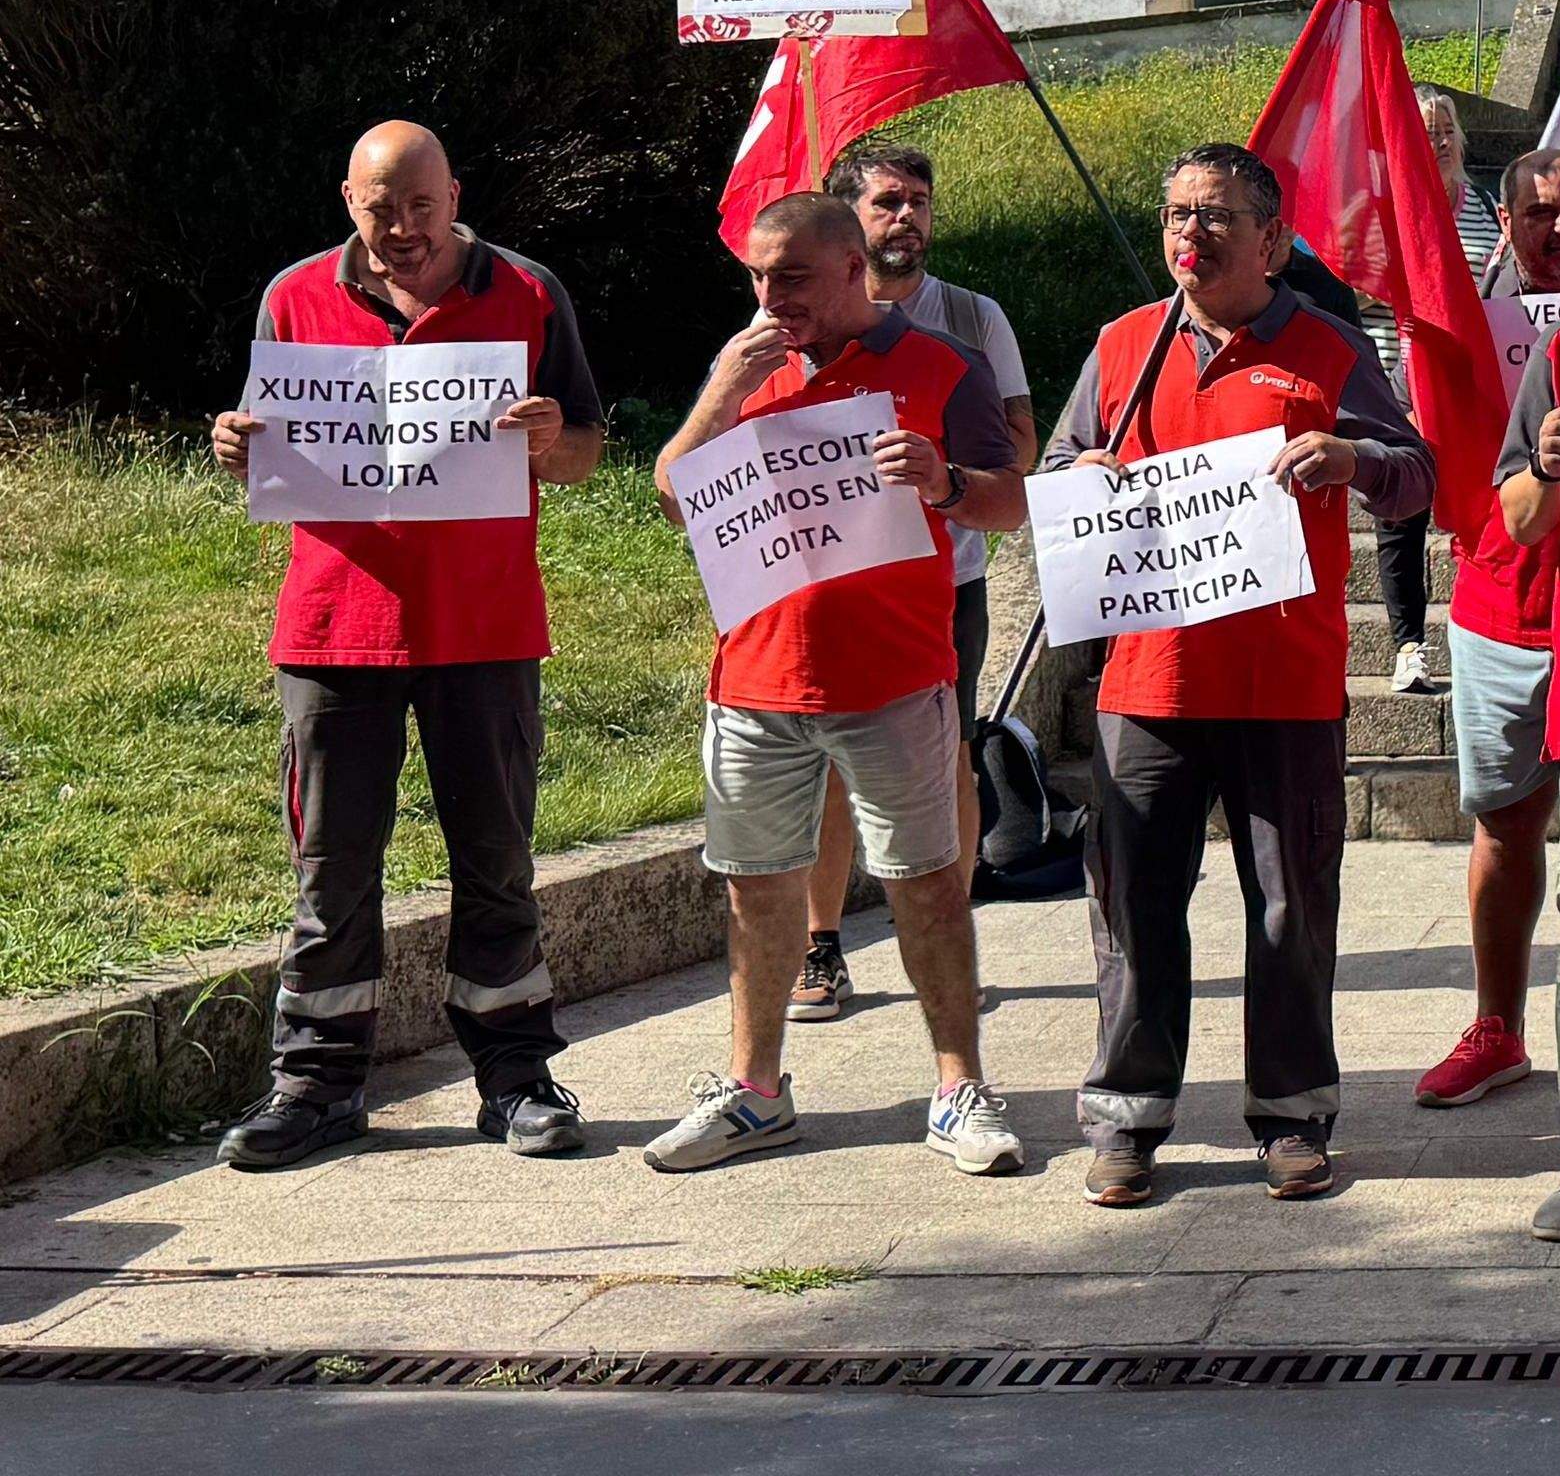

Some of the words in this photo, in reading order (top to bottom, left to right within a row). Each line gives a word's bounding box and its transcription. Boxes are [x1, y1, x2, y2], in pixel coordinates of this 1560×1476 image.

[258, 377, 377, 404] XUNTA
[388, 378, 519, 403] ESCOITA
[286, 420, 438, 445] ESTAMOS
[451, 420, 491, 442] EN
[342, 464, 439, 487] LOITA
[685, 460, 760, 519] XUNTA
[1104, 453, 1213, 494] VEOLIA
[714, 483, 830, 549] ESTAMOS
[837, 472, 880, 501] EN
[1073, 481, 1258, 538] DISCRIMINA
[760, 524, 842, 568] LOITA
[1105, 553, 1127, 577] A
[1136, 530, 1243, 572] XUNTA
[1100, 568, 1262, 620] PARTICIPA
